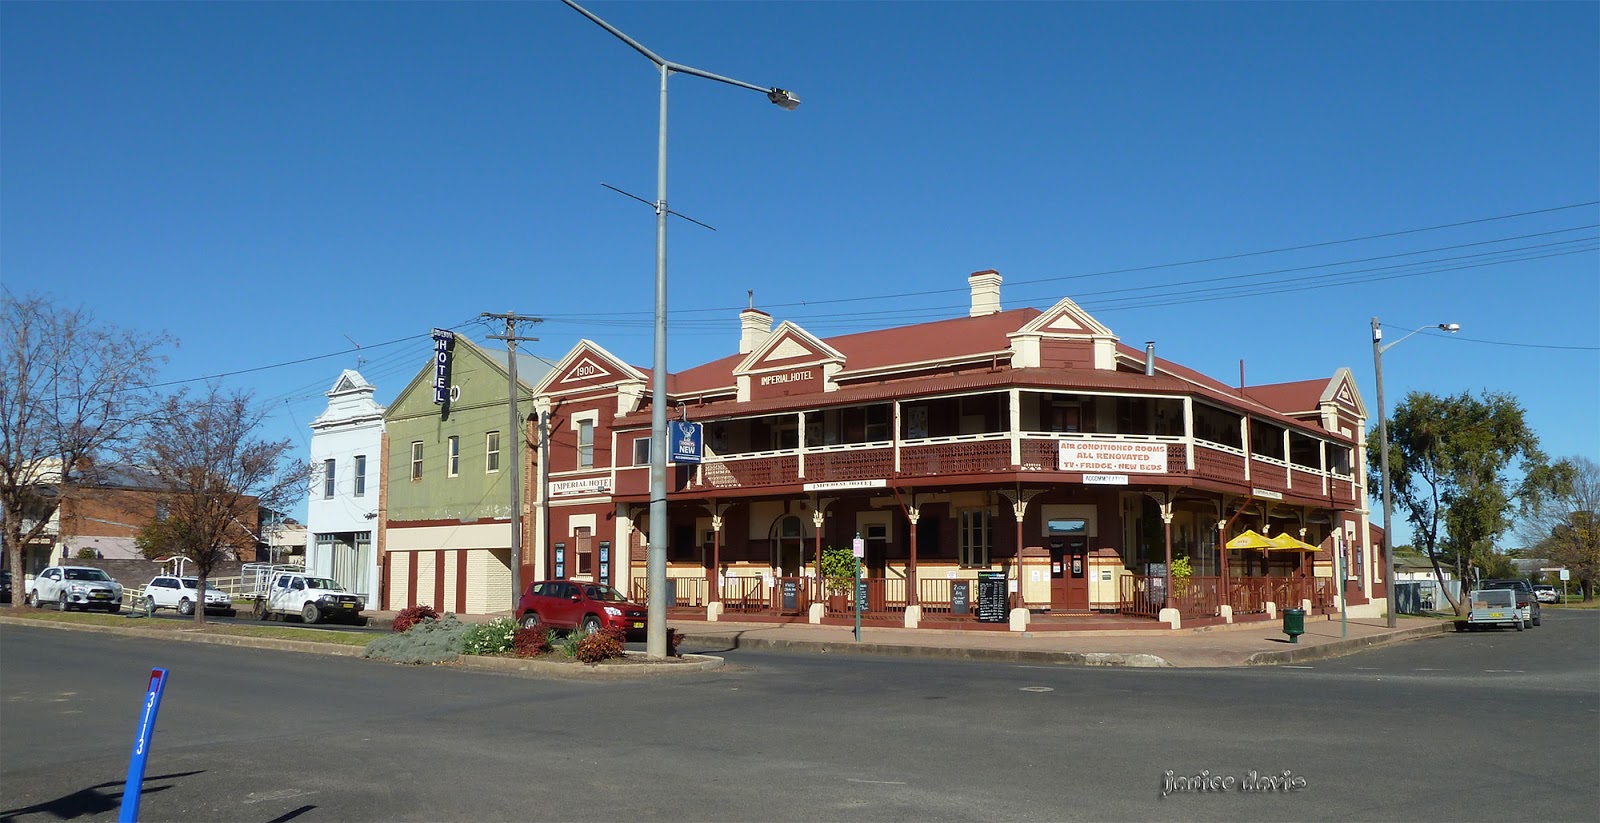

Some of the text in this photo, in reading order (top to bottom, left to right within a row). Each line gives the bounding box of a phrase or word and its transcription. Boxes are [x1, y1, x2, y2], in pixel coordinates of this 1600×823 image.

[437, 340, 447, 401] HOTEL
[577, 365, 595, 377] 1900
[761, 370, 814, 386] IMPERIAL HOTEL
[679, 445, 695, 454] NEW
[1077, 443, 1133, 452] CONDITIONED
[1096, 453, 1150, 461] RENOVATED
[553, 481, 587, 492] IMPERIAL
